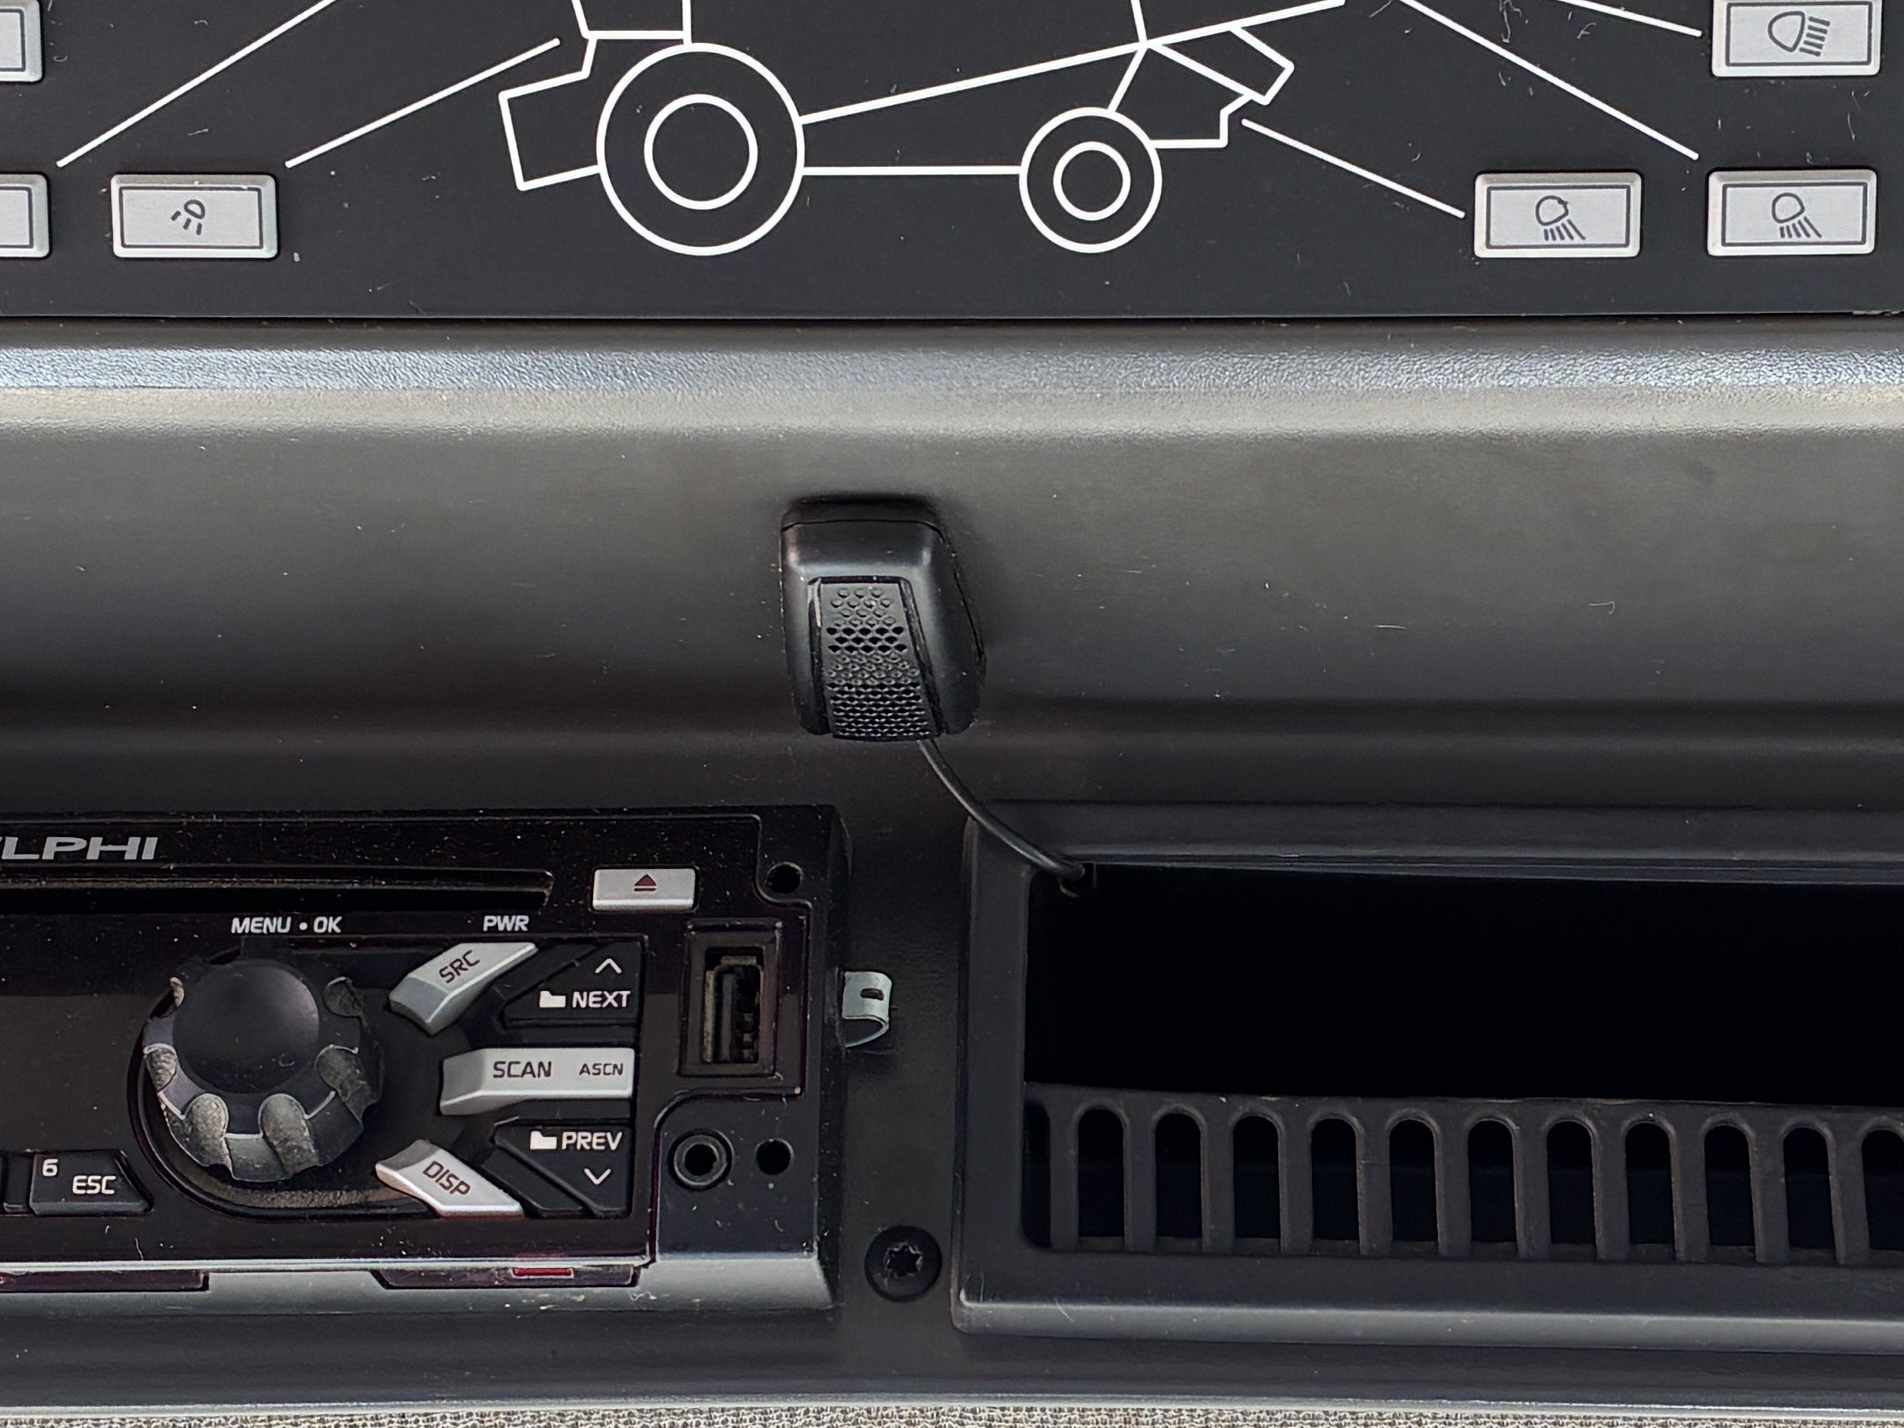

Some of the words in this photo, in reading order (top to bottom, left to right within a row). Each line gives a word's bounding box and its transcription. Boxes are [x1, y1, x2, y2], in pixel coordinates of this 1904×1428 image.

[230, 916, 292, 935] MENU
[312, 915, 344, 934] OK
[482, 913, 531, 933] PWR
[438, 949, 481, 986] SRC
[571, 989, 632, 1010] NEXT
[492, 1060, 553, 1080] SCAN
[578, 1061, 625, 1077] ASCN
[560, 1130, 624, 1152] PREV
[41, 1157, 60, 1178] 6
[71, 1174, 118, 1196] ESC
[422, 1159, 471, 1198] DISP
